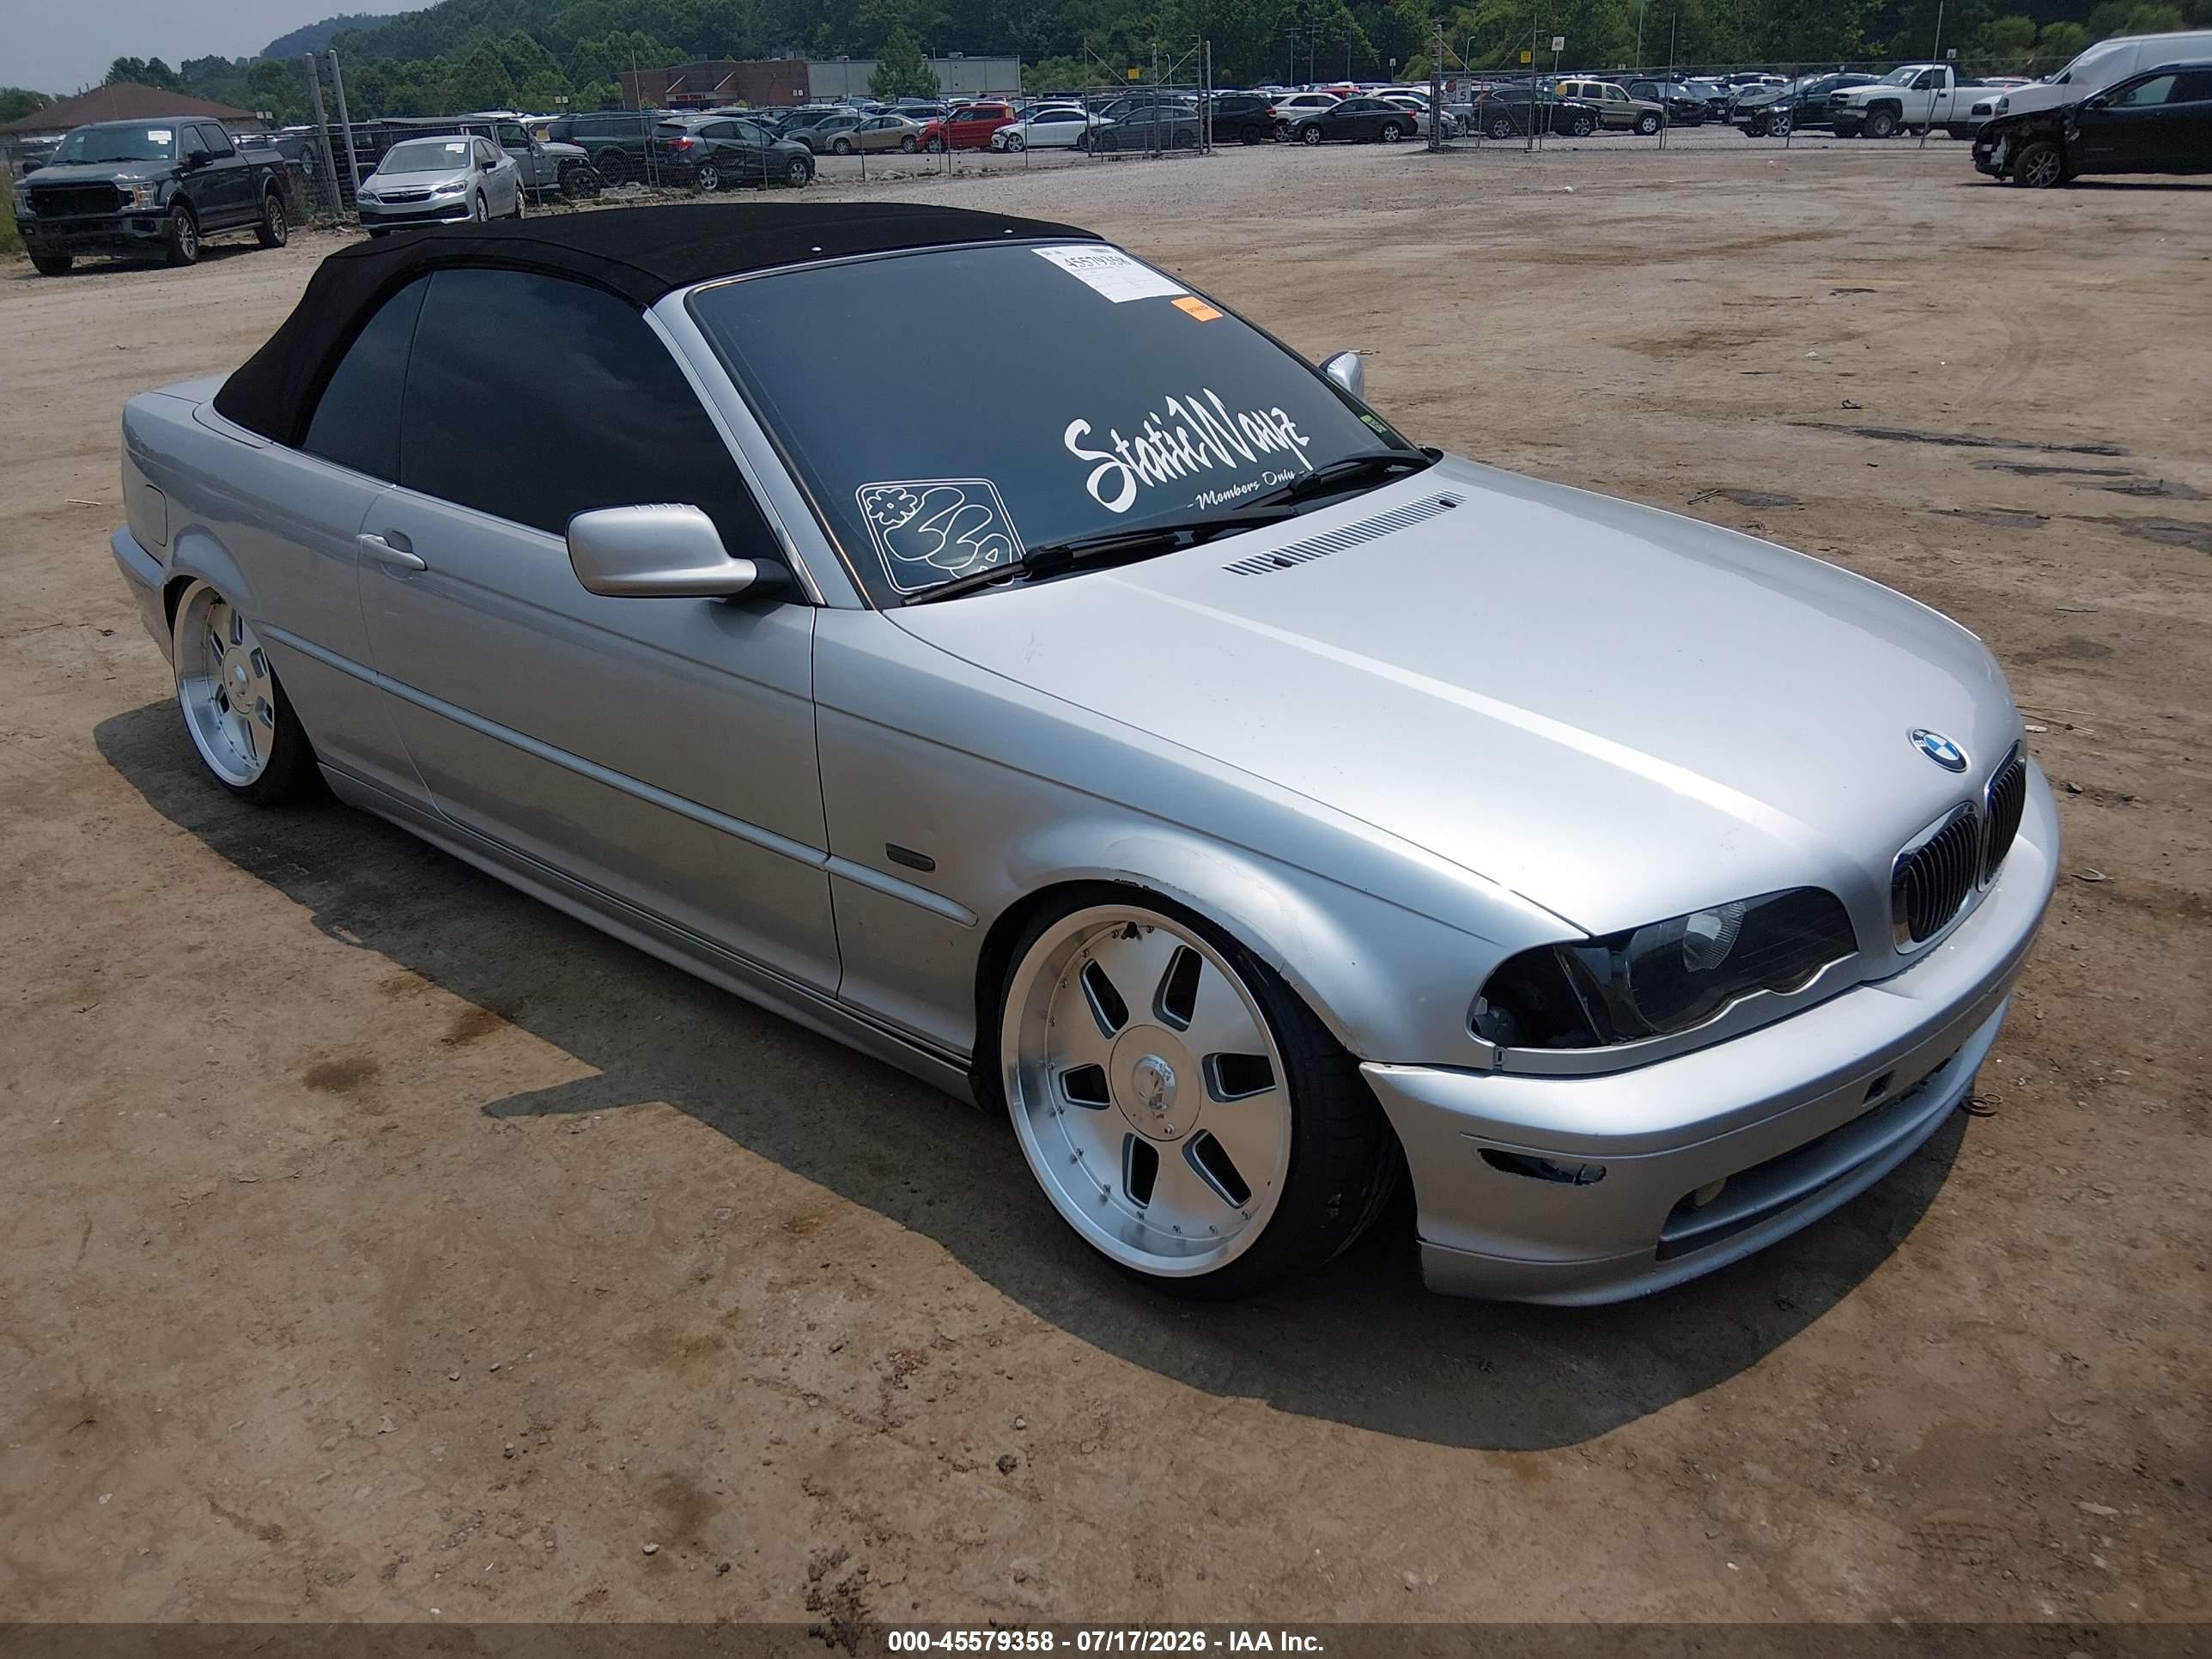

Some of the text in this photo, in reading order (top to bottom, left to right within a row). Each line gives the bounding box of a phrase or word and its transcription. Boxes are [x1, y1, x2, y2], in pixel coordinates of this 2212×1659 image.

[1460, 91, 1467, 100] 5
[1195, 481, 1261, 510] Members
[1262, 469, 1296, 486] Only
